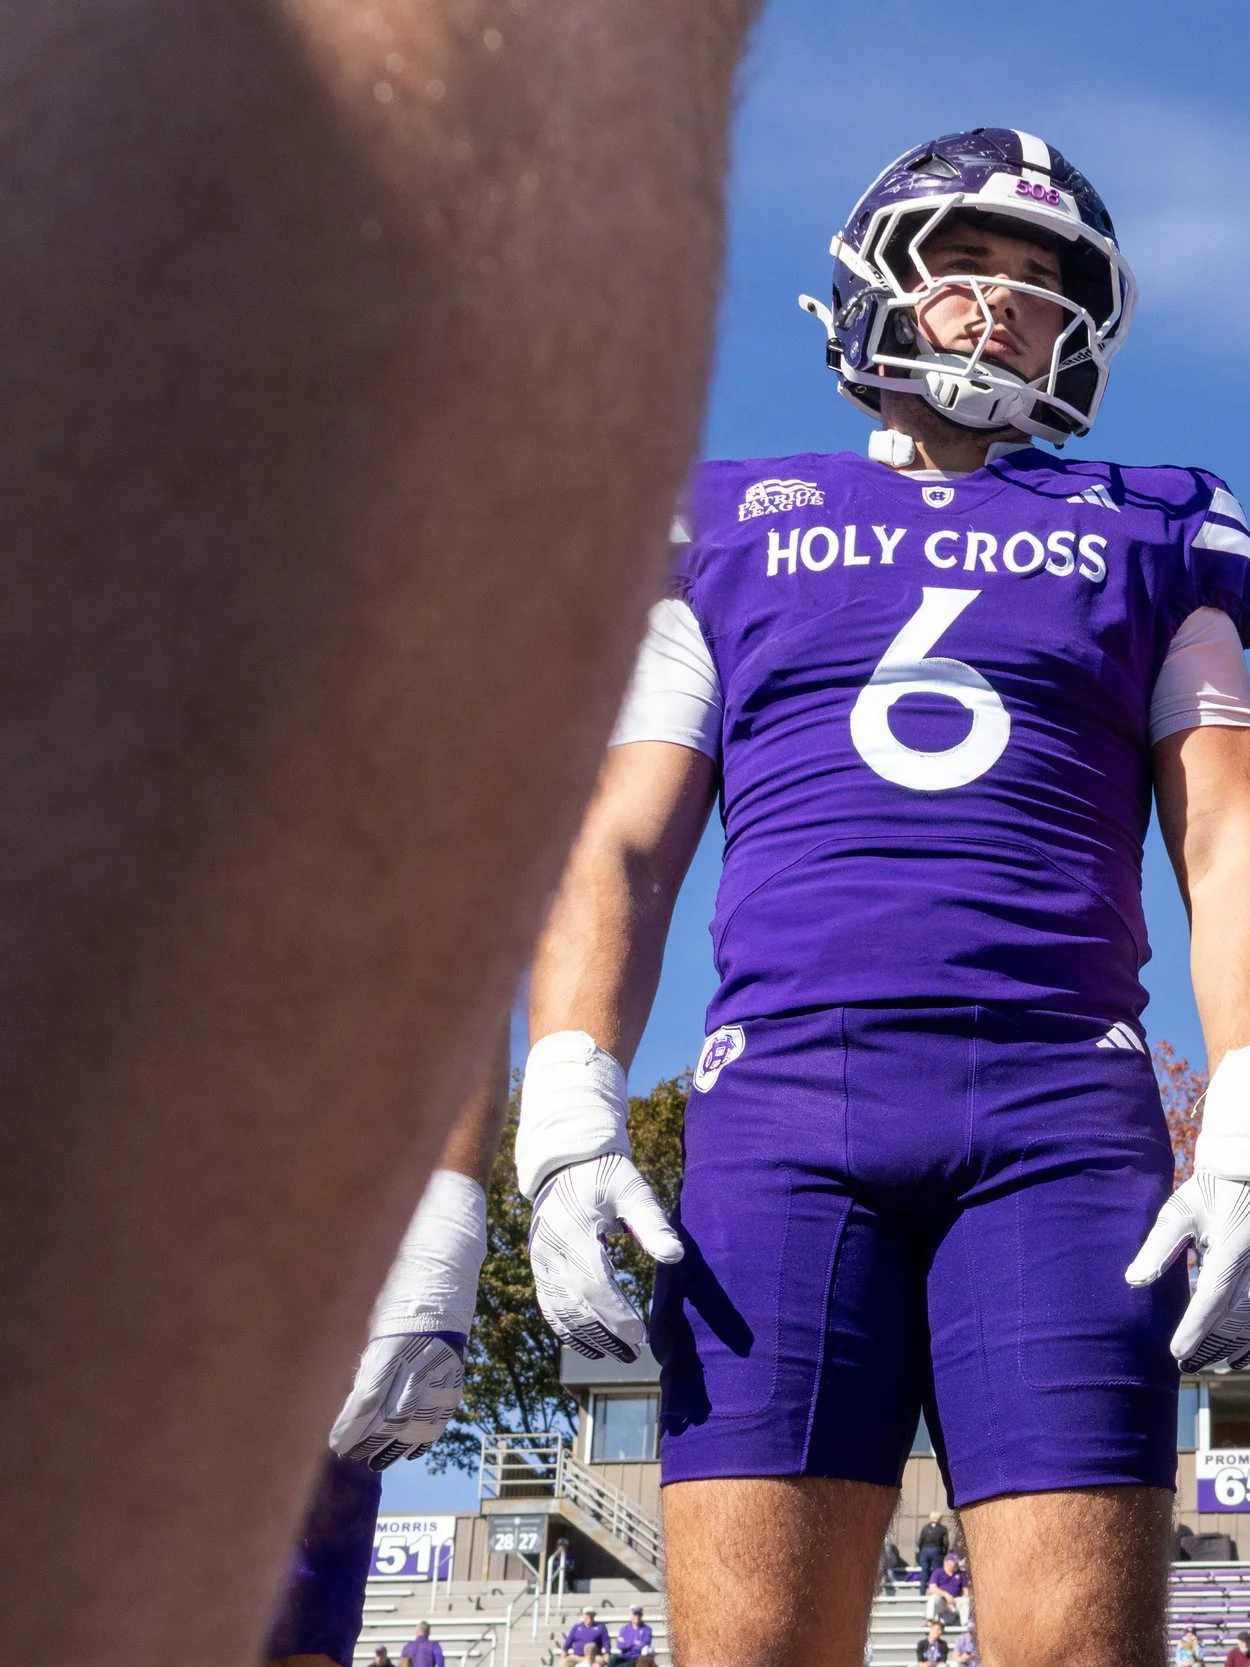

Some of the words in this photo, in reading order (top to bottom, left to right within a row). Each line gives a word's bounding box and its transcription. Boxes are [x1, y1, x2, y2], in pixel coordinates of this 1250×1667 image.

[1015, 179, 1060, 206] 508
[738, 489, 825, 514] PATRIOT
[738, 499, 824, 522] LEAGUE
[766, 525, 907, 577] HOLY
[924, 530, 1107, 583] CROSS
[850, 586, 1011, 791] 6
[376, 1522, 437, 1532] MORRIS
[375, 1535, 432, 1574] 51
[494, 1533, 514, 1550] 28
[518, 1533, 538, 1550] 27
